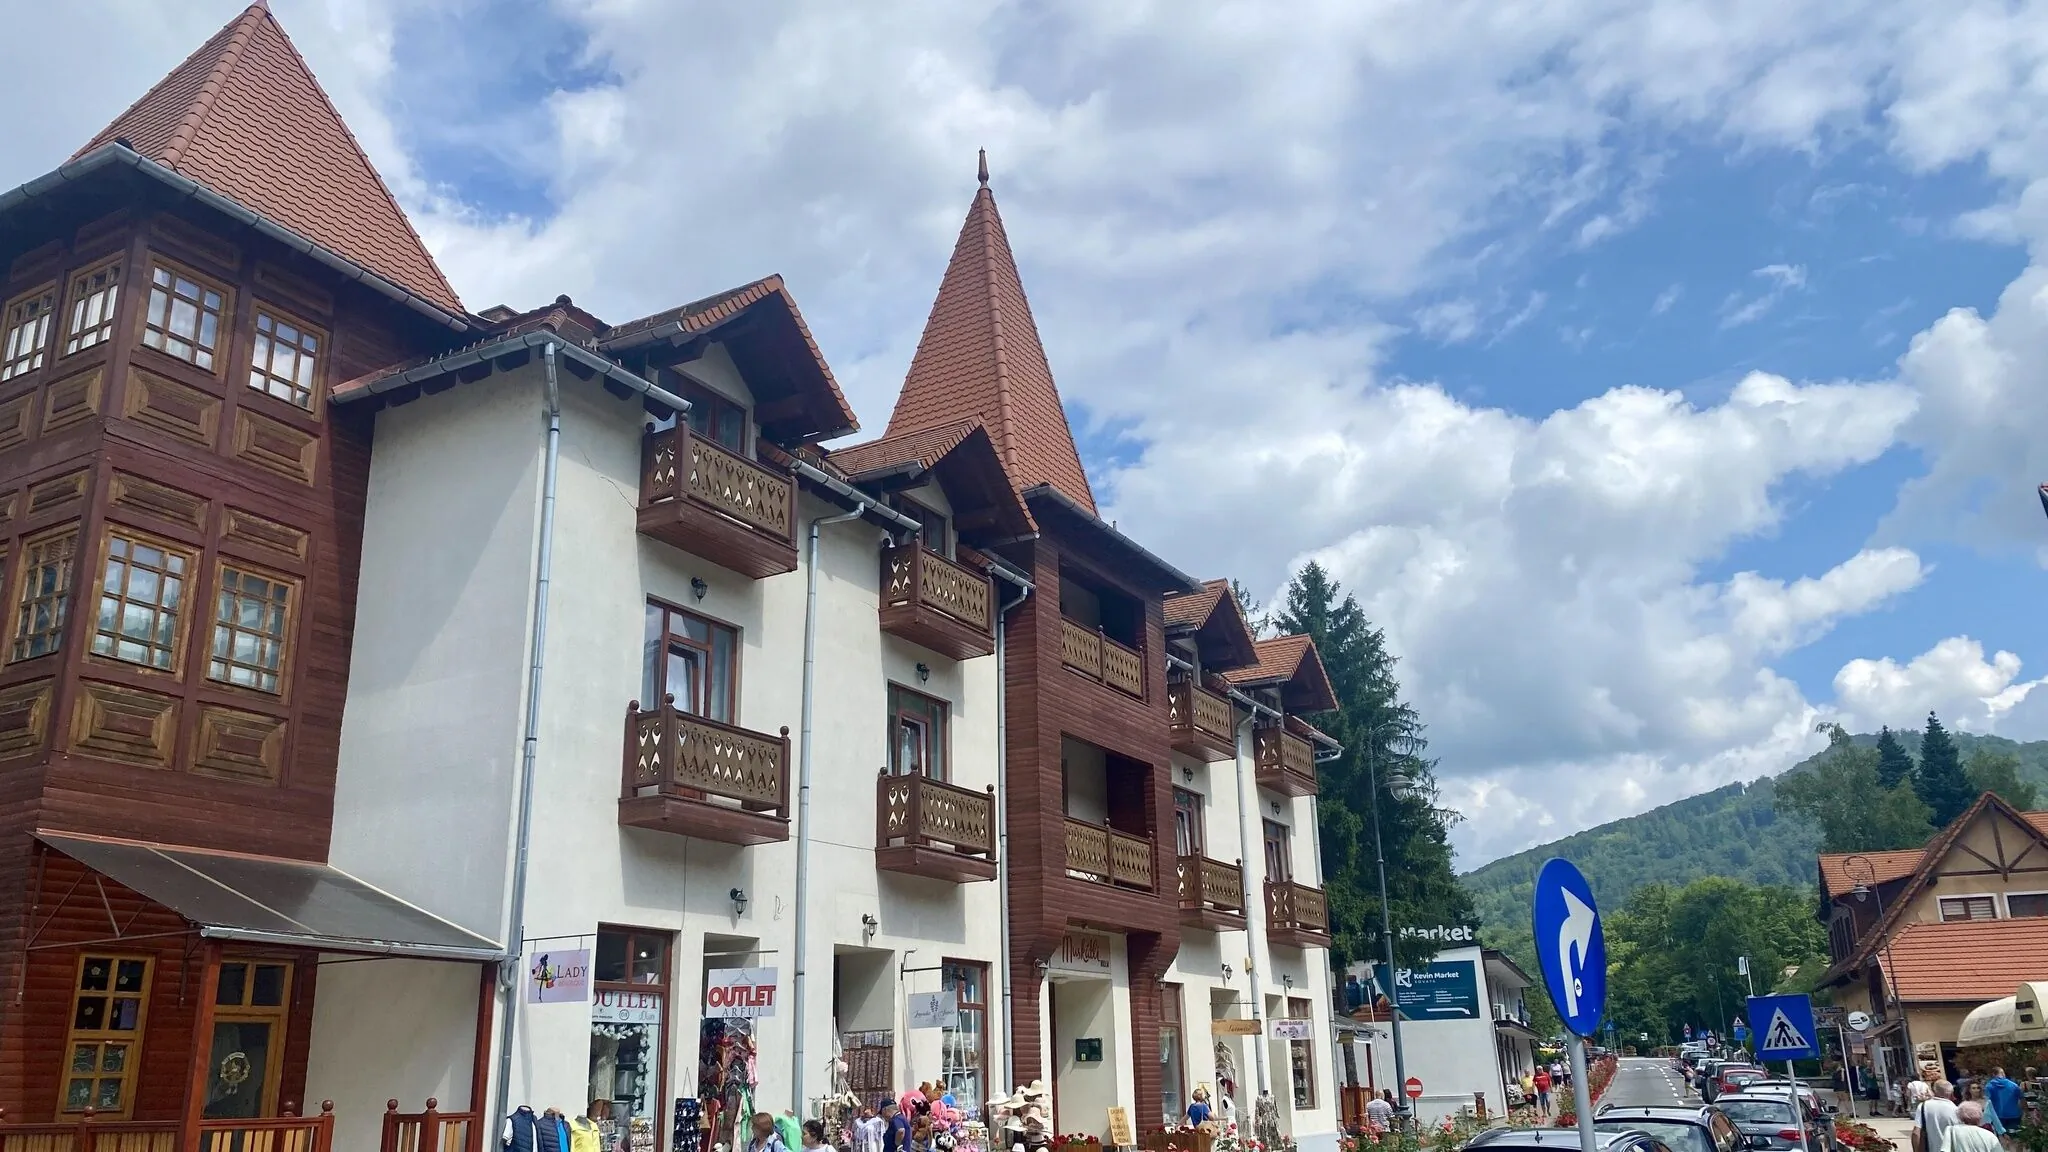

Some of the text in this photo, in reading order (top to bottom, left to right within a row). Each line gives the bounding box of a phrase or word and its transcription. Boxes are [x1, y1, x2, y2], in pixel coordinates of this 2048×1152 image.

[1400, 925, 1473, 941] Market
[557, 965, 588, 979] LADY
[708, 986, 776, 1008] OUTLET
[721, 1007, 763, 1017] ARFUL
